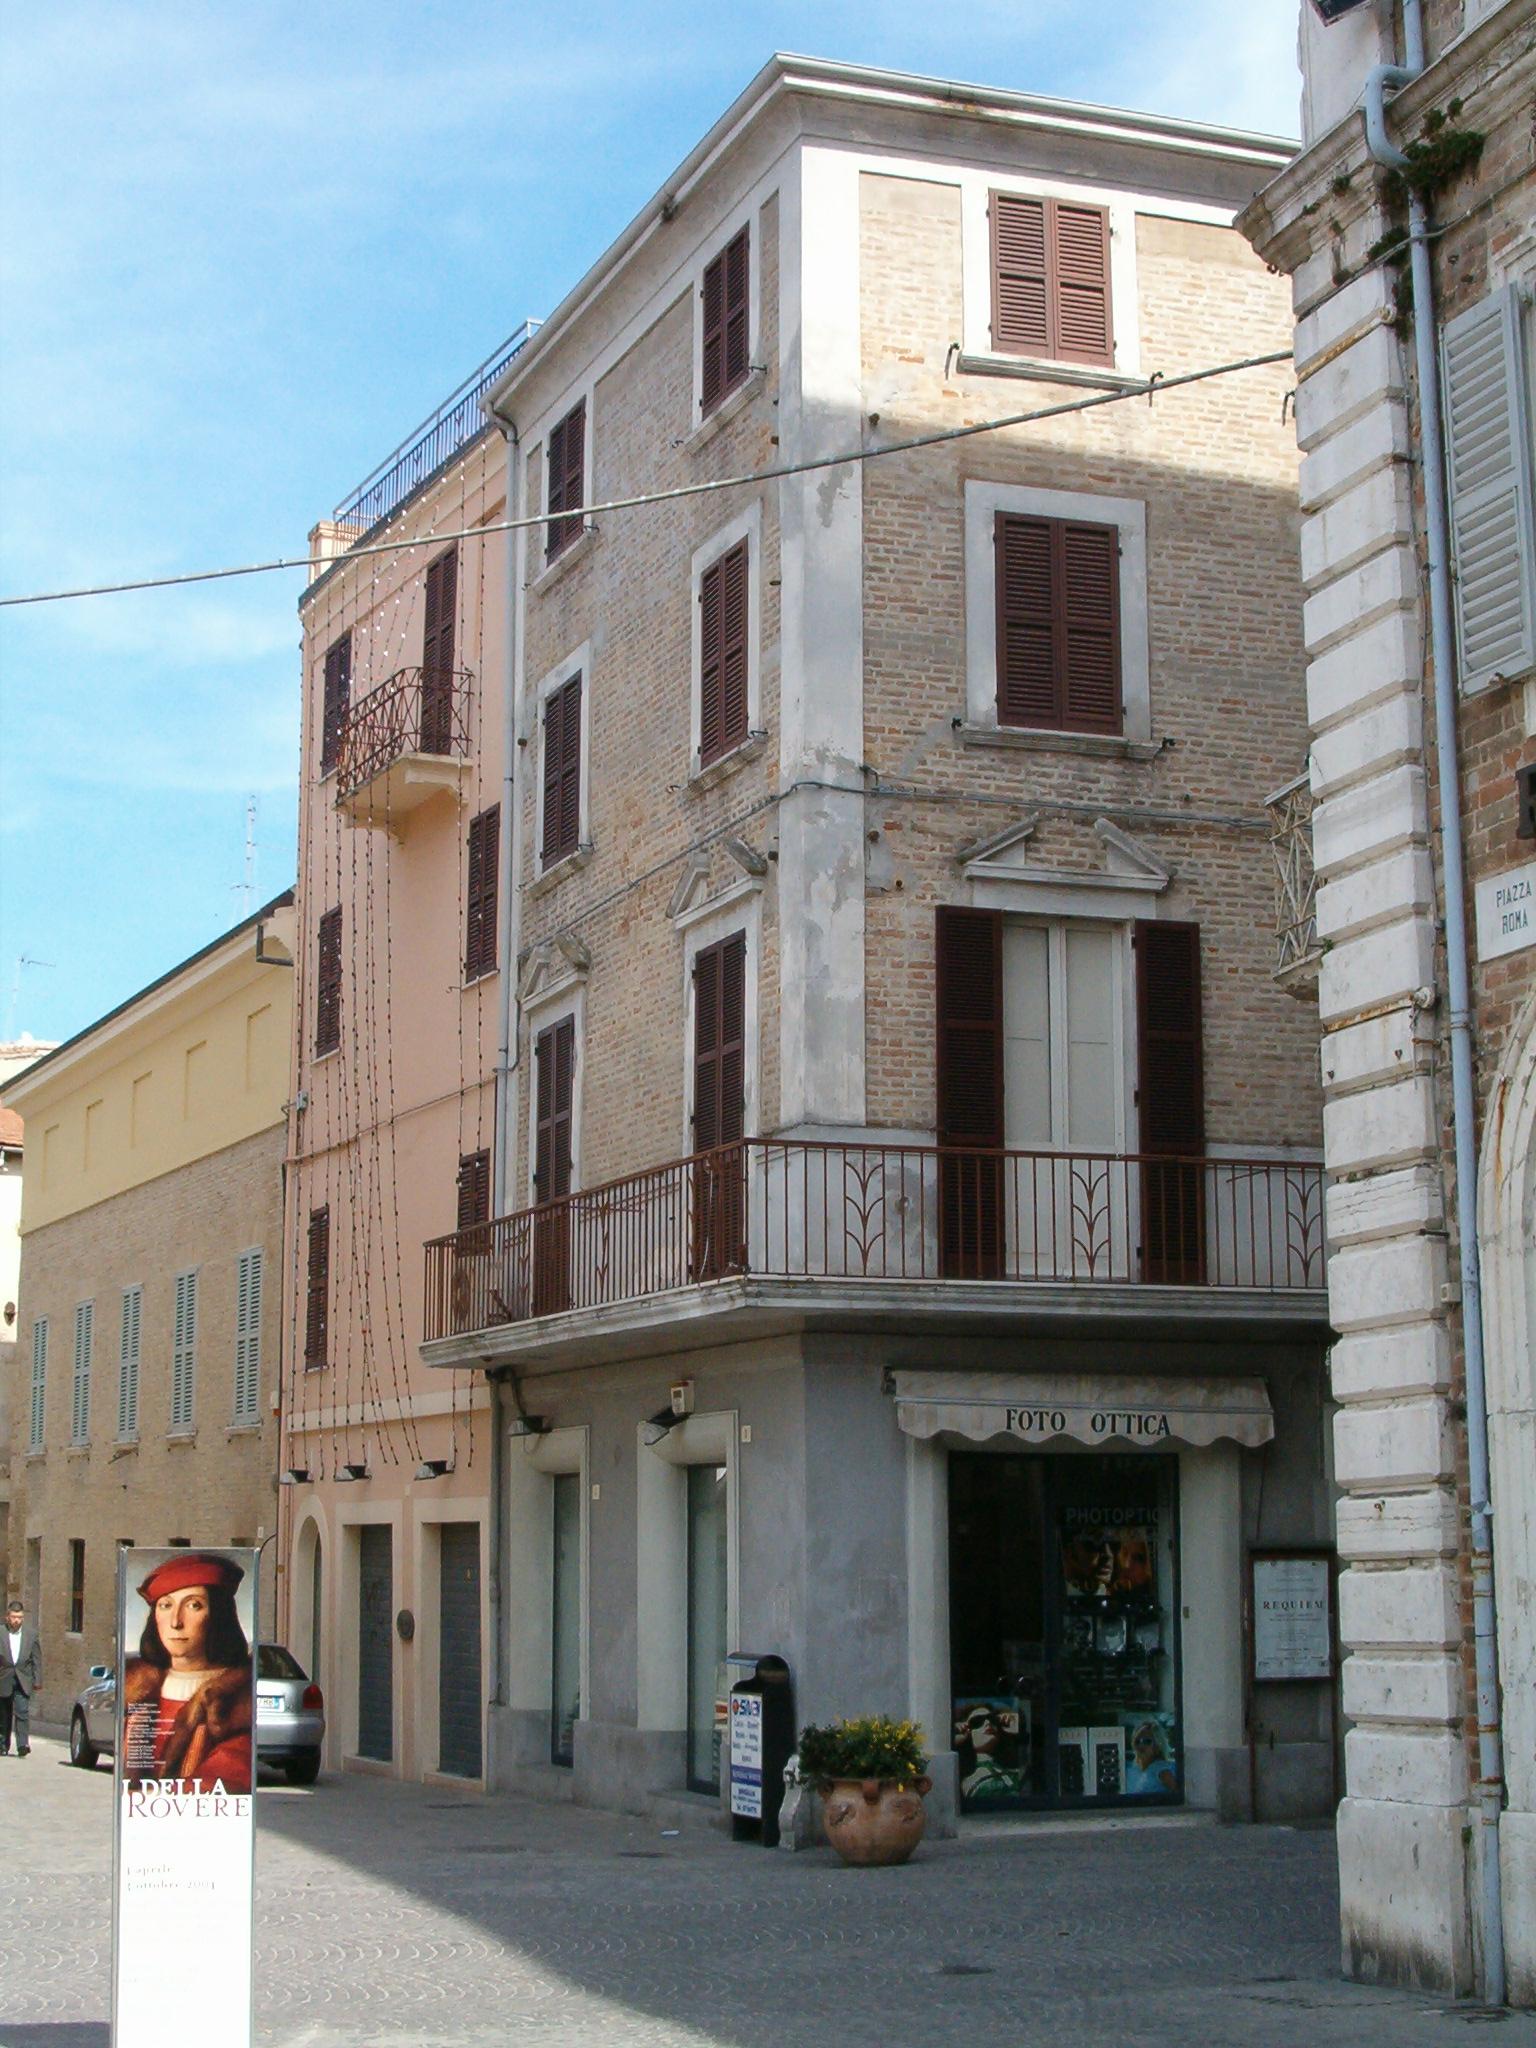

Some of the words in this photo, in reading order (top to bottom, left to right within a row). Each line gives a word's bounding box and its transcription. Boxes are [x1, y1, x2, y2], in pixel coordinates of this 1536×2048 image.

[1496, 880, 1532, 907] PIAZZA
[1502, 908, 1528, 935] ROMA
[1006, 1408, 1067, 1432] FOTO
[1091, 1412, 1172, 1436] OTTICA
[1262, 1600, 1325, 1611] REQUIEM
[122, 1779, 131, 1797] I
[140, 1778, 228, 1797] DELLA
[128, 1791, 249, 1818] ROVERE
